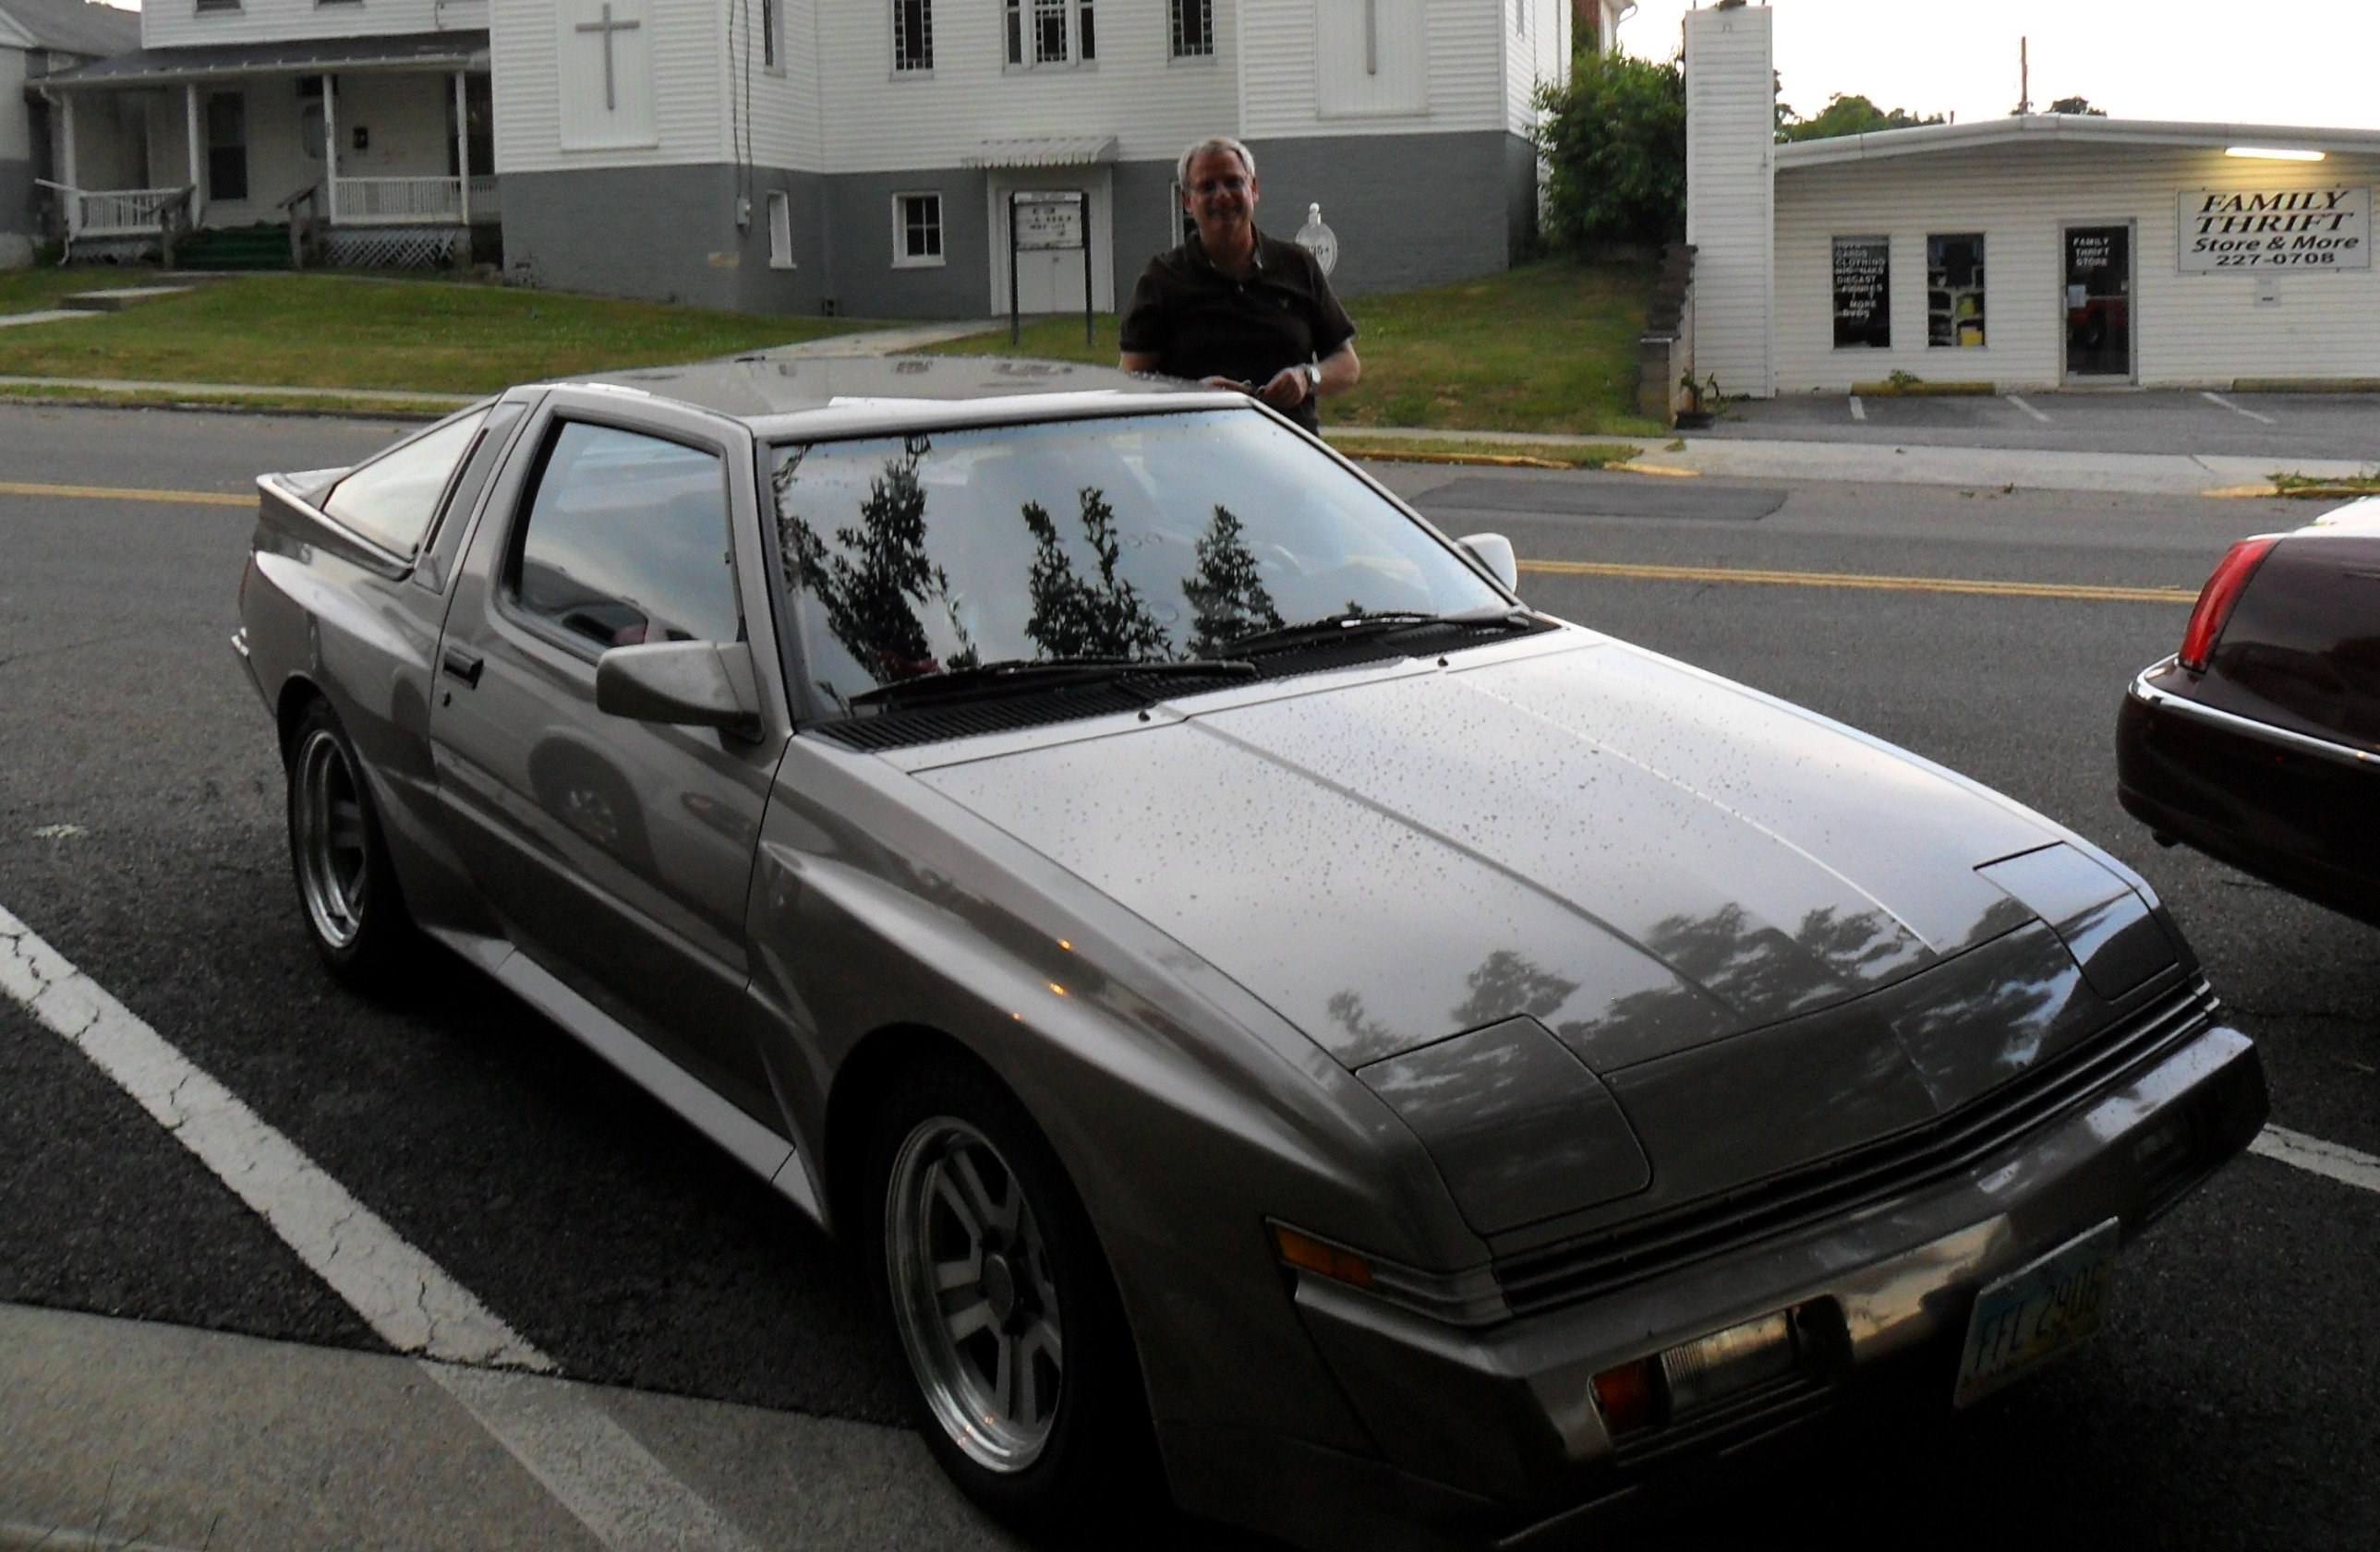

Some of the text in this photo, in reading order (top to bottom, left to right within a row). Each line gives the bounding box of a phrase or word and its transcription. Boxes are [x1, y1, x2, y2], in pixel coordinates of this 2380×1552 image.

[2199, 190, 2350, 212] FAMILY
[2196, 211, 2354, 235] THRIFT
[2073, 237, 2108, 247] FAMILY
[2192, 235, 2359, 253] Store & More
[2217, 252, 2335, 266] 227-0708
